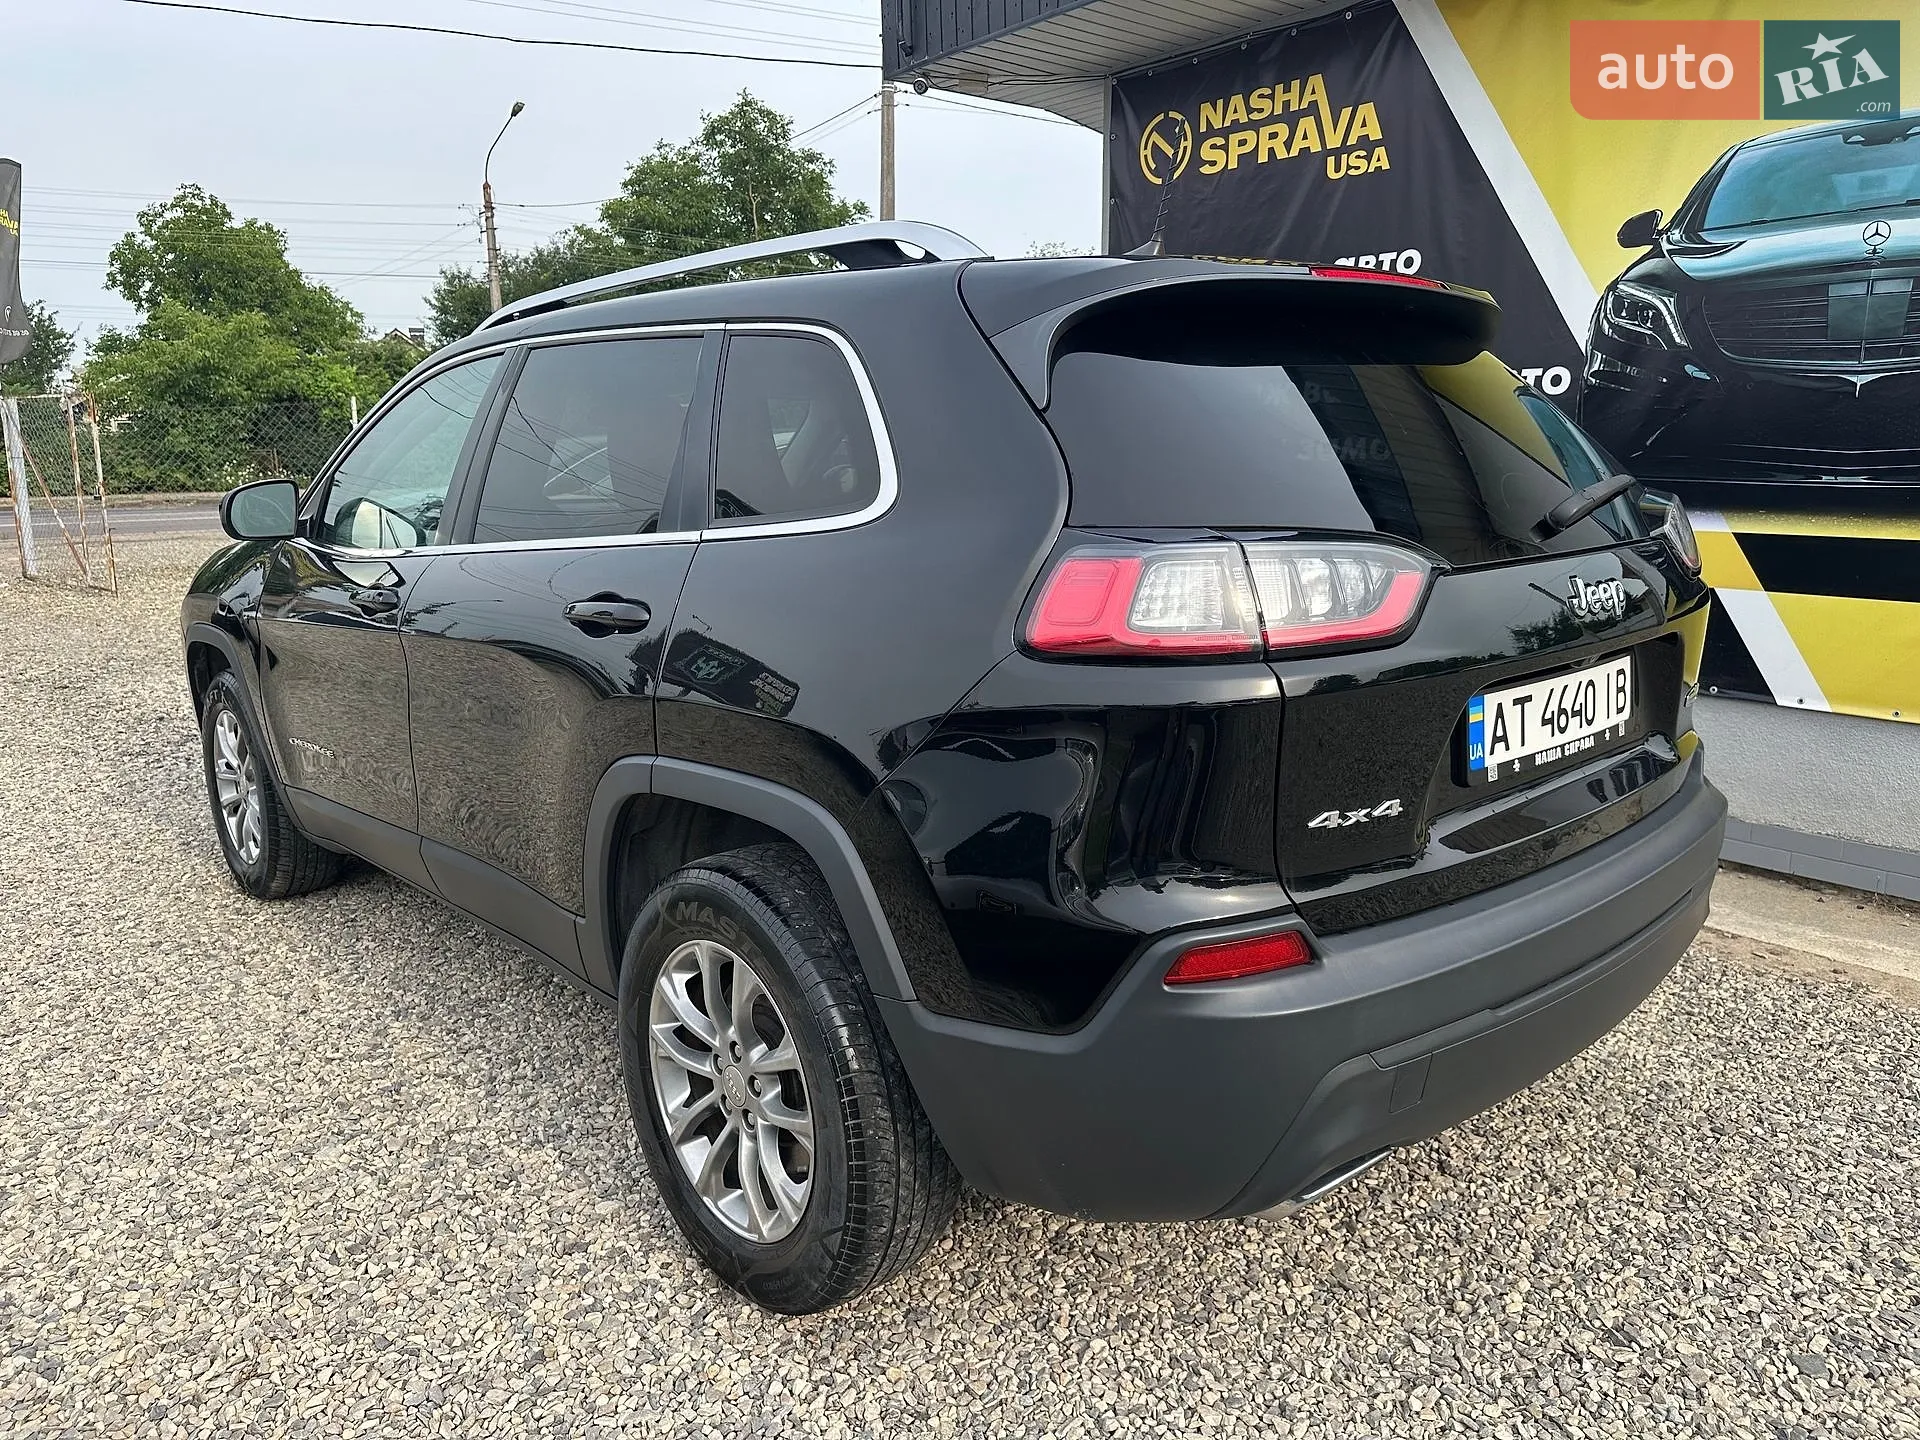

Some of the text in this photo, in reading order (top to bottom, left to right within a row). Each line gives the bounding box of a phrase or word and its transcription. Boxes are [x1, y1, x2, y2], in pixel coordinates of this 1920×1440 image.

[1199, 73, 1328, 132] NASHA
[1199, 101, 1383, 175] SPRAVA
[1326, 146, 1390, 180] USA
[1567, 575, 1626, 620] Jeep
[1489, 667, 1627, 756] AT 4640 IB
[1470, 743, 1483, 761] UA
[1534, 735, 1595, 766] НАША СПРАВА
